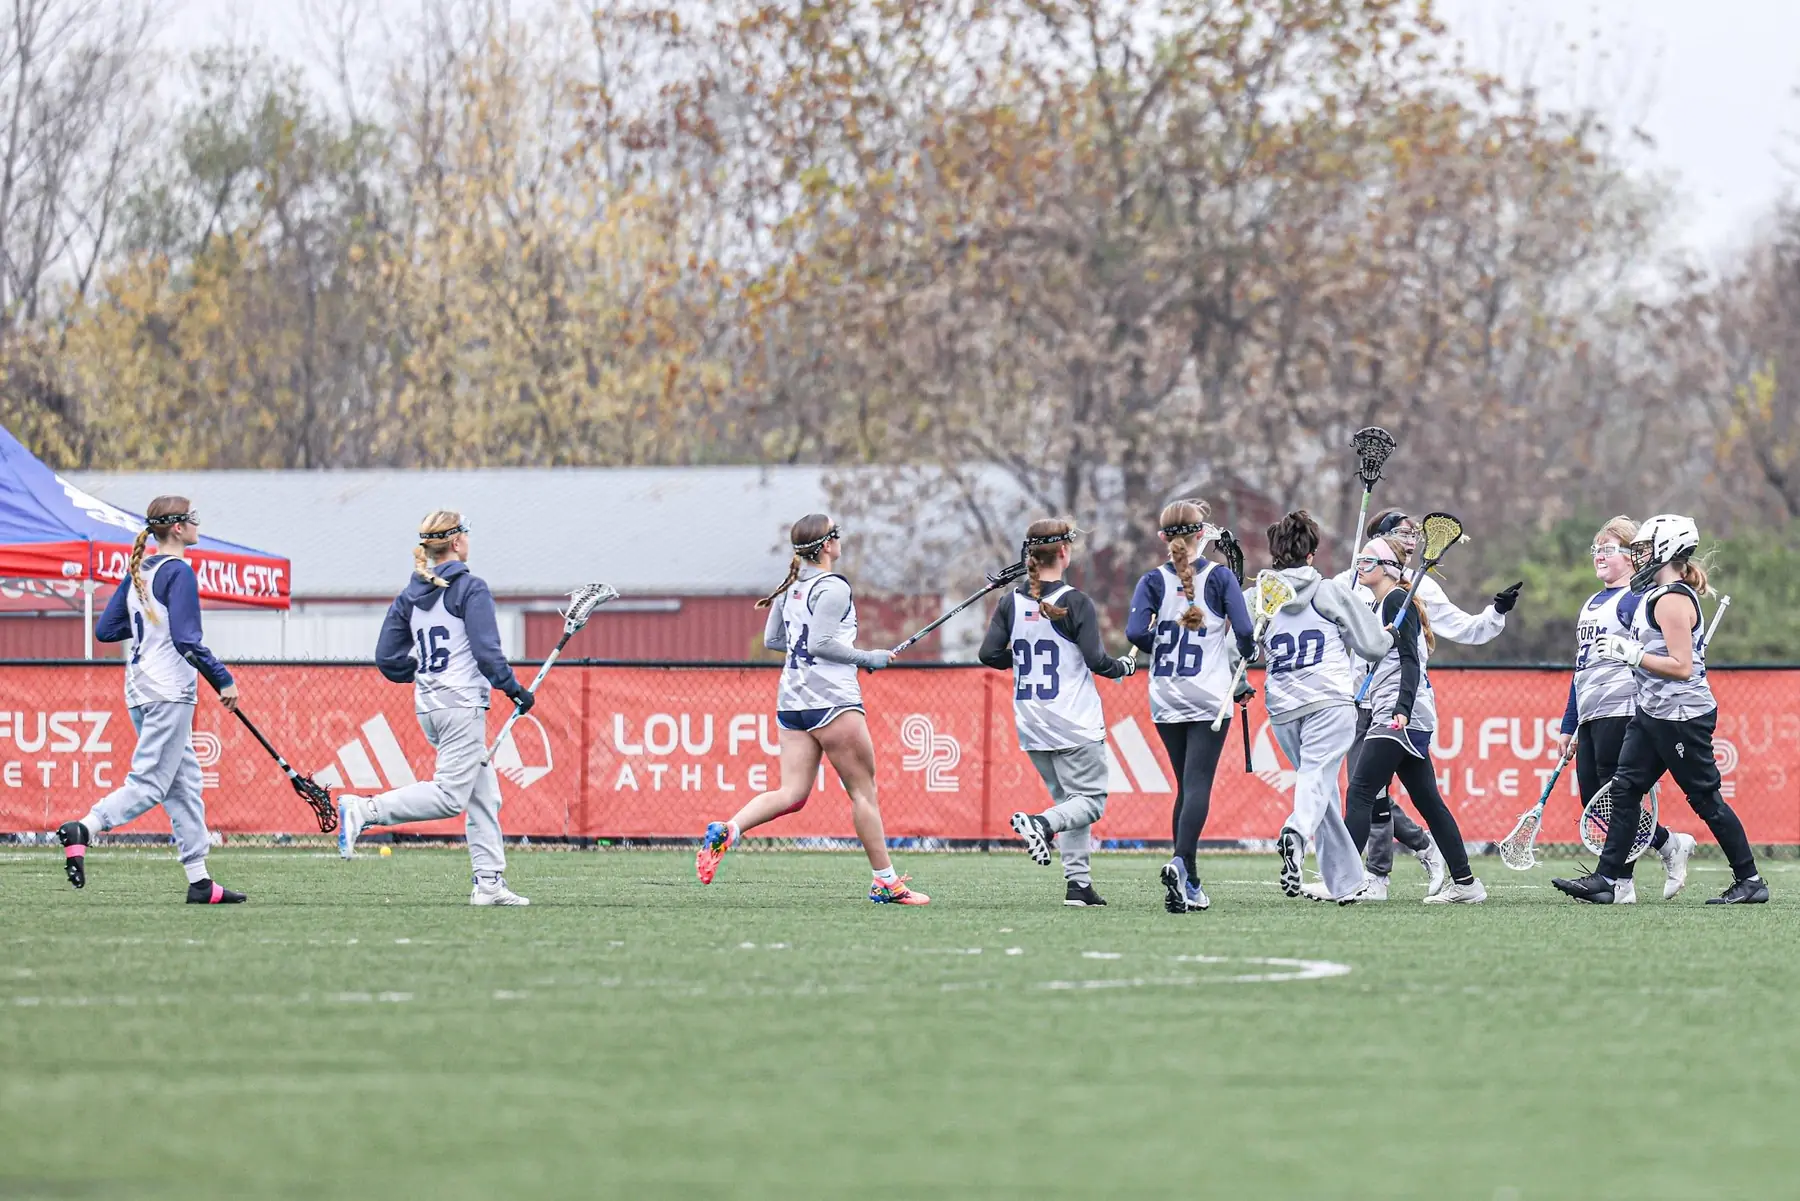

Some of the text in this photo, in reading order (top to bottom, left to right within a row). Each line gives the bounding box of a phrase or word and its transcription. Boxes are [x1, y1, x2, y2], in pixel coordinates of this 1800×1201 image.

[197, 559, 283, 598] ATHLETIC
[417, 626, 451, 673] 16
[1013, 639, 1059, 700] 23
[1155, 620, 1207, 676] 26
[1270, 629, 1325, 674] 20
[614, 713, 781, 756] LOU FU
[901, 713, 961, 792] 92
[1478, 717, 1562, 760] FUS
[614, 764, 846, 792] ATHLEI
